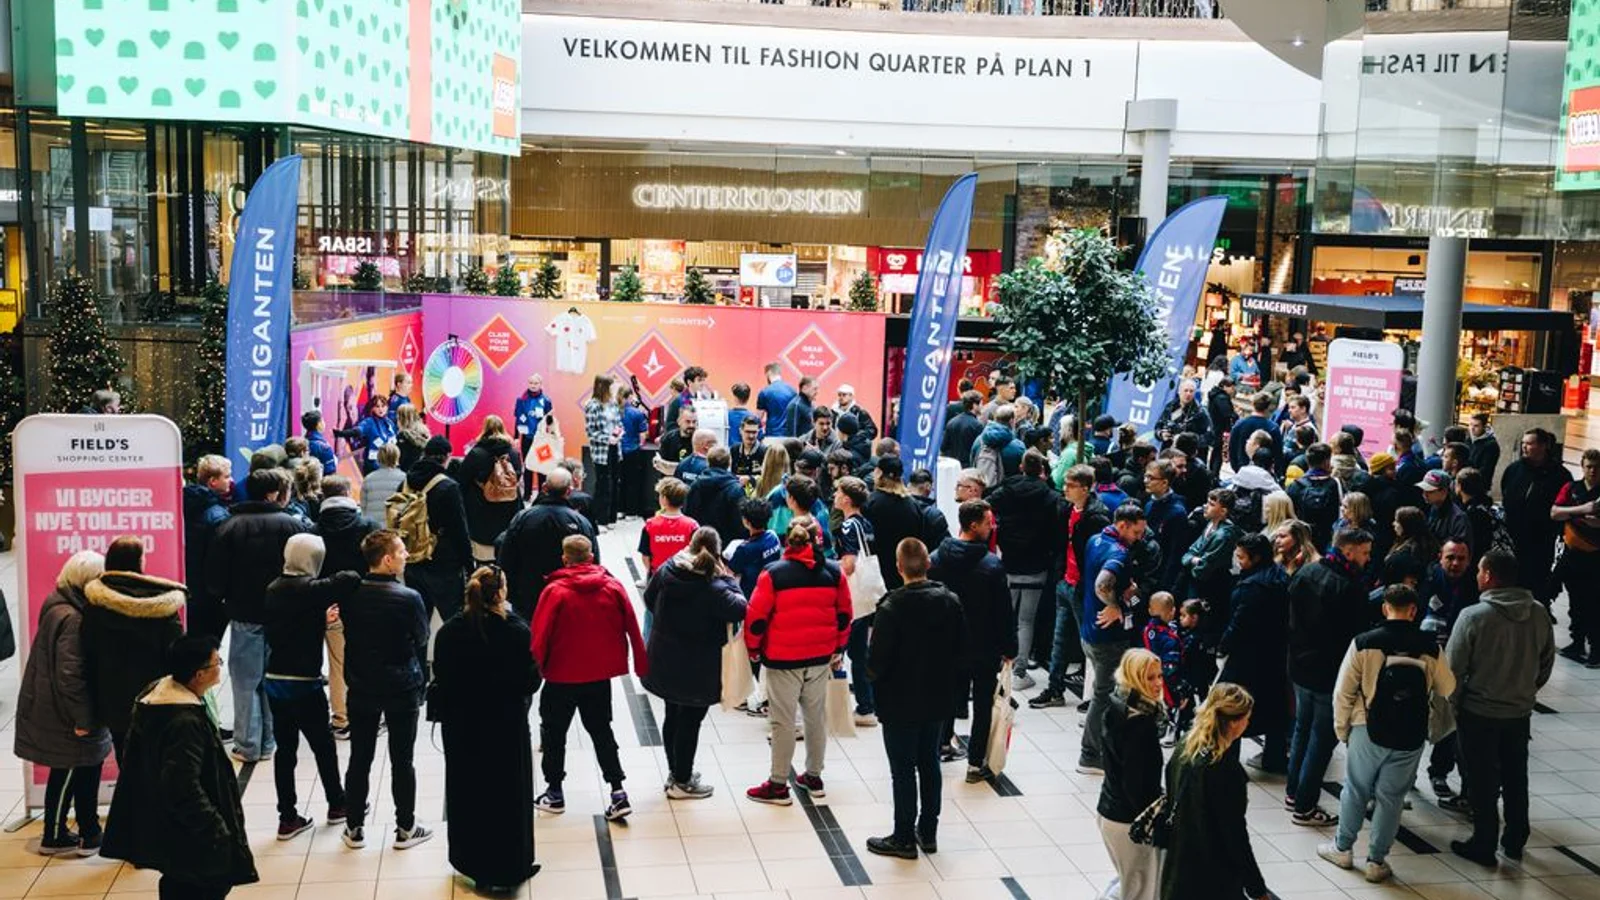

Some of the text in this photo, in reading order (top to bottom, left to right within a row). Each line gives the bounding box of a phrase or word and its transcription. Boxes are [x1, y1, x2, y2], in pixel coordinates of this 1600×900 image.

[563, 37, 1091, 78] VELKOMMEN TIL FASHION QUARTER PÅ PLAN 1
[633, 183, 863, 213] CENTERKIOSKEN
[1243, 298, 1308, 316] LAGKAGEHUSET
[251, 227, 275, 441] ELGIGANTEN
[912, 250, 952, 470] ELGIGANTEN
[71, 438, 130, 451] FIELD'S
[57, 455, 144, 463] SHOPPING CENTER
[56, 488, 153, 507] VI BYGGER
[35, 511, 175, 531] NYE TOILETTER
[56, 531, 83, 553] PÅ
[655, 535, 685, 543] DEVICE
